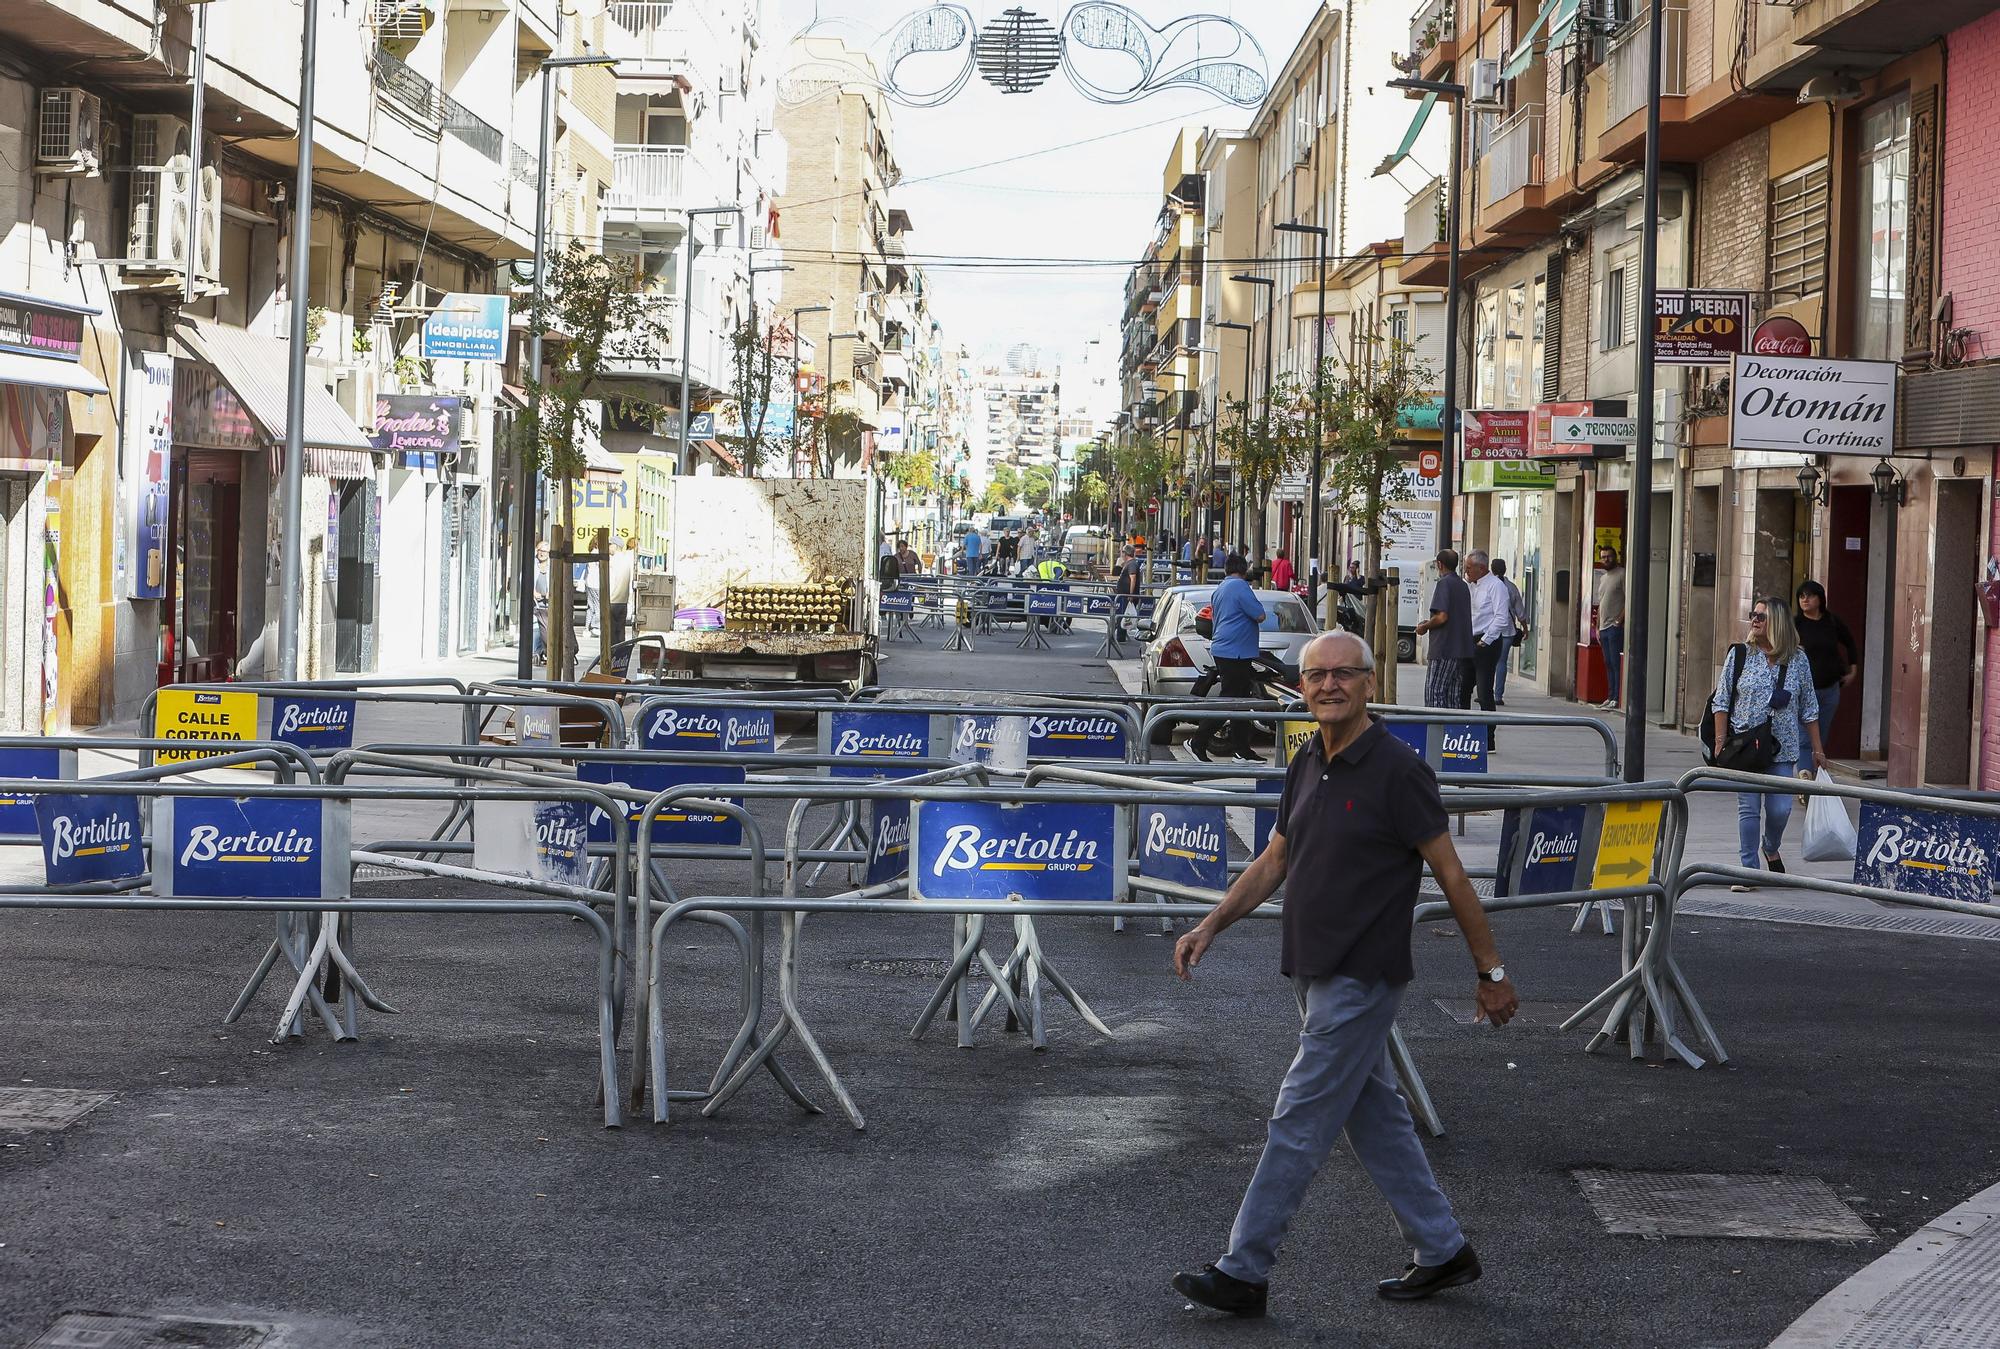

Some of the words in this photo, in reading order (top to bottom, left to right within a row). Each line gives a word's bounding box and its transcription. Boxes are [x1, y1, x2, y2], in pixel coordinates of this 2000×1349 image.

[431, 340, 496, 351] INMOBILIARIA
[1741, 362, 1843, 383] Decoración
[1740, 387, 1886, 424] Otomán
[390, 432, 444, 449] Lencería
[1585, 423, 1637, 437] TECNOCAS
[1803, 428, 1884, 448] Cortinas
[1486, 448, 1505, 458] 602
[1506, 448, 1523, 458] 674
[1417, 489, 1441, 498] TIEND
[1403, 512, 1433, 520] TELECOM
[178, 711, 230, 726] CALLE
[277, 704, 348, 737] Bertolín
[649, 708, 720, 739] Berto
[1028, 715, 1119, 739] Bertolín
[165, 729, 242, 740] CORTADA
[725, 717, 770, 751] Bertolín
[834, 730, 922, 755] Bertolín
[158, 749, 191, 760] POR
[52, 812, 132, 866] Bertolín
[1145, 812, 1220, 857] Bertolín
[180, 825, 314, 867] Bertolín
[933, 824, 1098, 877] Bertolín
[1525, 831, 1578, 870] Bertolín
[1866, 824, 1989, 868] Bertolín
[1048, 863, 1077, 872] GRUPO
[1946, 865, 1968, 875] GRUPO
